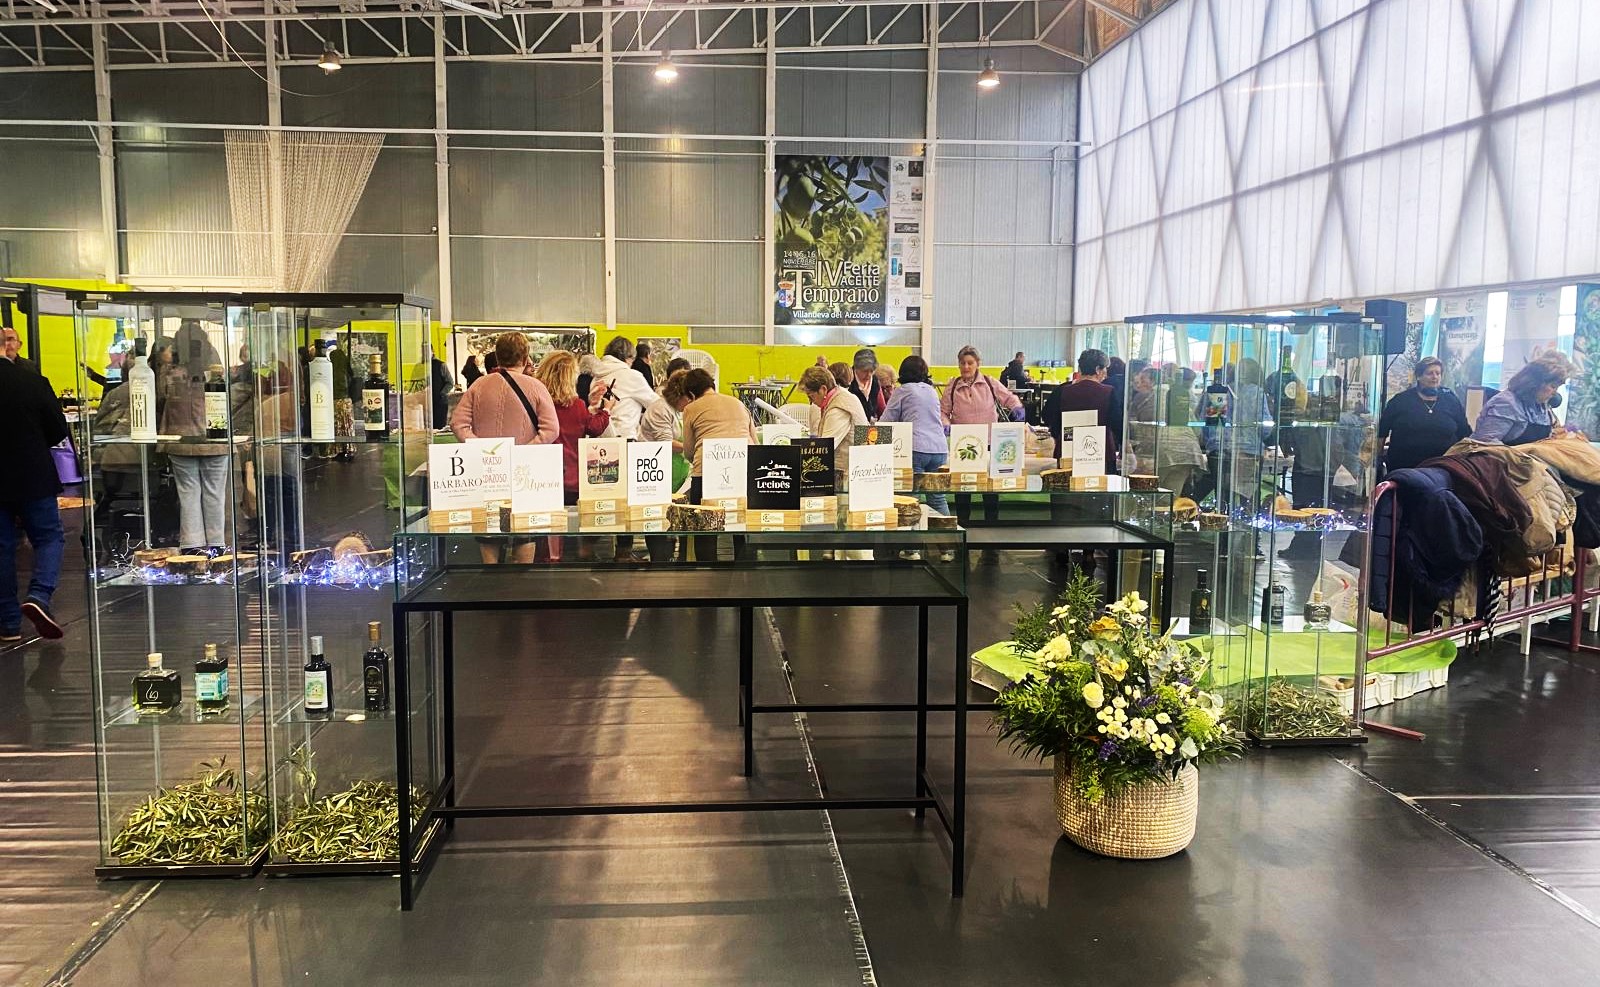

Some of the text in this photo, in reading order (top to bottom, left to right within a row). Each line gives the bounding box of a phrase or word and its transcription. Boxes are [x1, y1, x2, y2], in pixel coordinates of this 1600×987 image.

[817, 260, 880, 287] IV Feria
[840, 275, 880, 286] ACEITE
[783, 269, 879, 310] Temprano
[793, 310, 880, 320] Villanueva del Arzobispo
[709, 450, 746, 461] MALEZAS
[636, 470, 664, 482] LOGO
[433, 478, 483, 490] BÁRBARO
